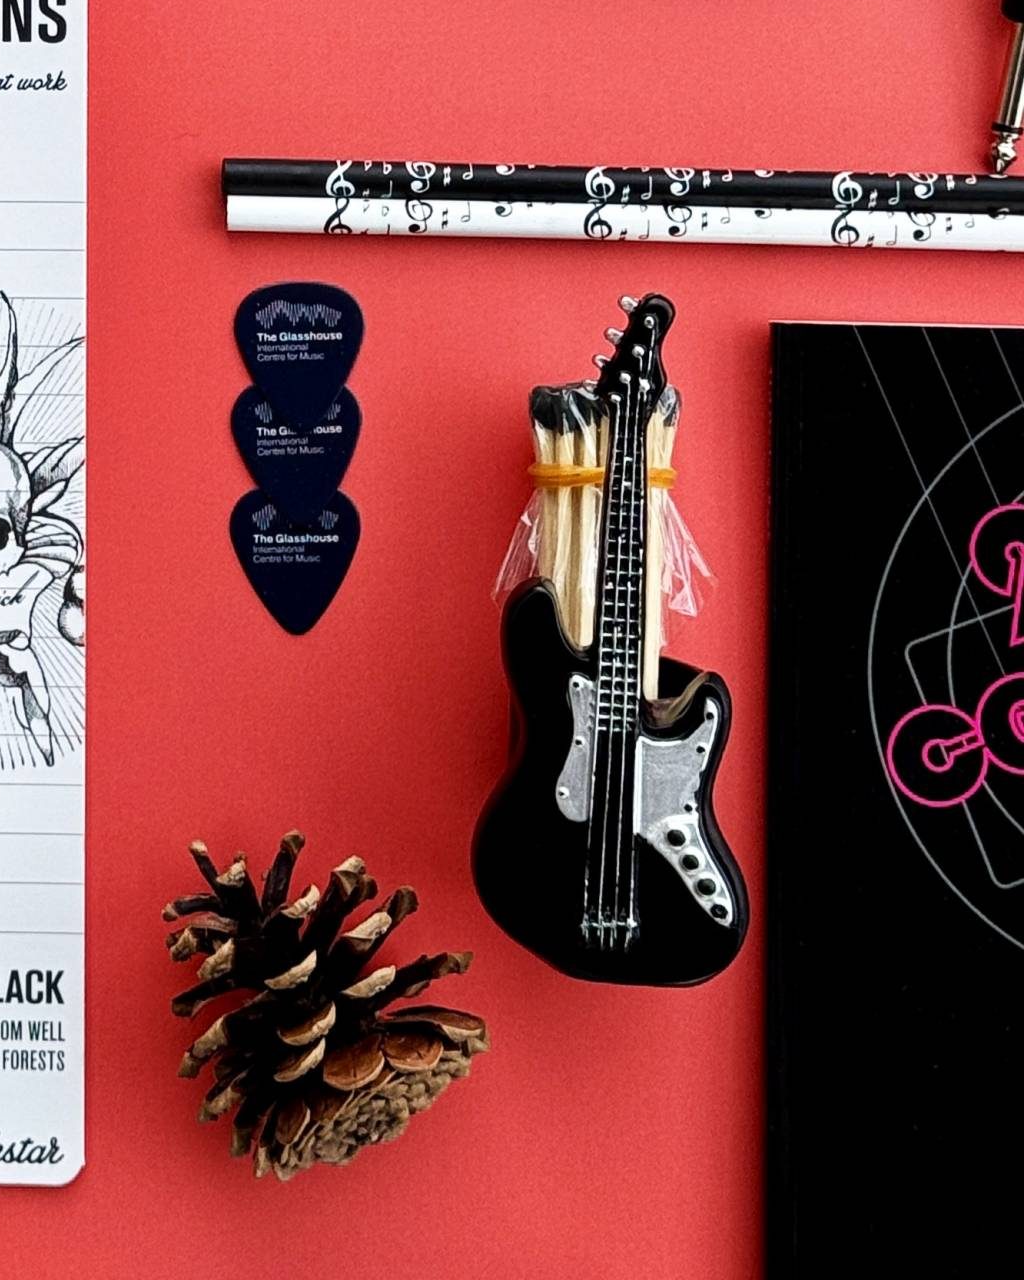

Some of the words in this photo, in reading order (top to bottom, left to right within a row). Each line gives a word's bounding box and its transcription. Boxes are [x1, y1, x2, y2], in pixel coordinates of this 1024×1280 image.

[17, 70, 68, 92] work
[256, 332, 276, 342] The
[279, 331, 343, 341] Glasshouse
[257, 343, 309, 352] International
[257, 353, 285, 362] Centre
[287, 352, 298, 361] for
[299, 352, 324, 361] Music
[256, 426, 277, 437] The
[257, 437, 309, 446] International
[253, 534, 274, 544] The
[275, 533, 339, 544] Glasshouse
[253, 545, 305, 553] International
[283, 554, 294, 563] for
[295, 554, 320, 563] Music
[28, 1021, 65, 1041] WELL
[2, 1050, 65, 1071] FORESTS
